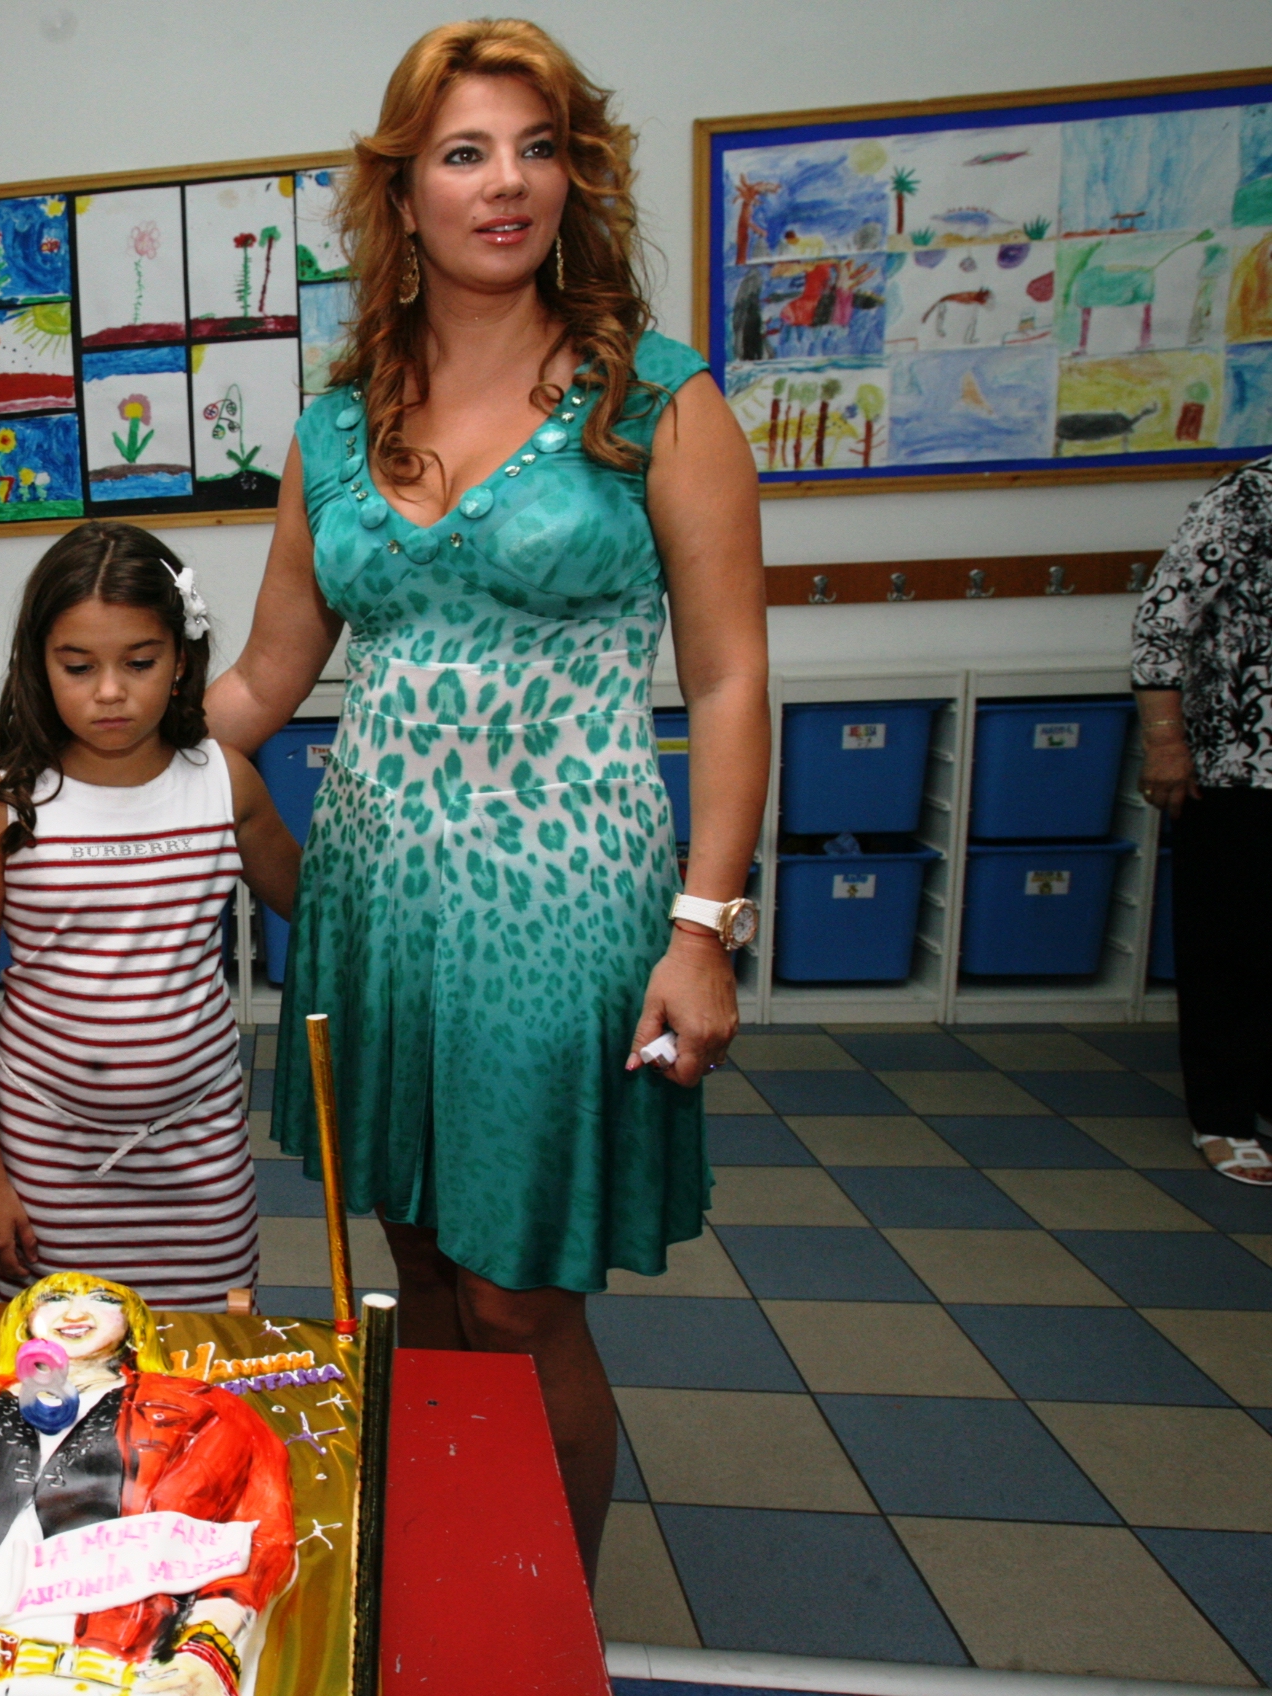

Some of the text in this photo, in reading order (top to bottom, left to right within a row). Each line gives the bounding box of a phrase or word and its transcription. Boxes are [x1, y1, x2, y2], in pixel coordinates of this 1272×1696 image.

[70, 837, 194, 859] BURBERRY
[215, 1364, 346, 1396] ONTANA
[34, 1536, 69, 1568] LA
